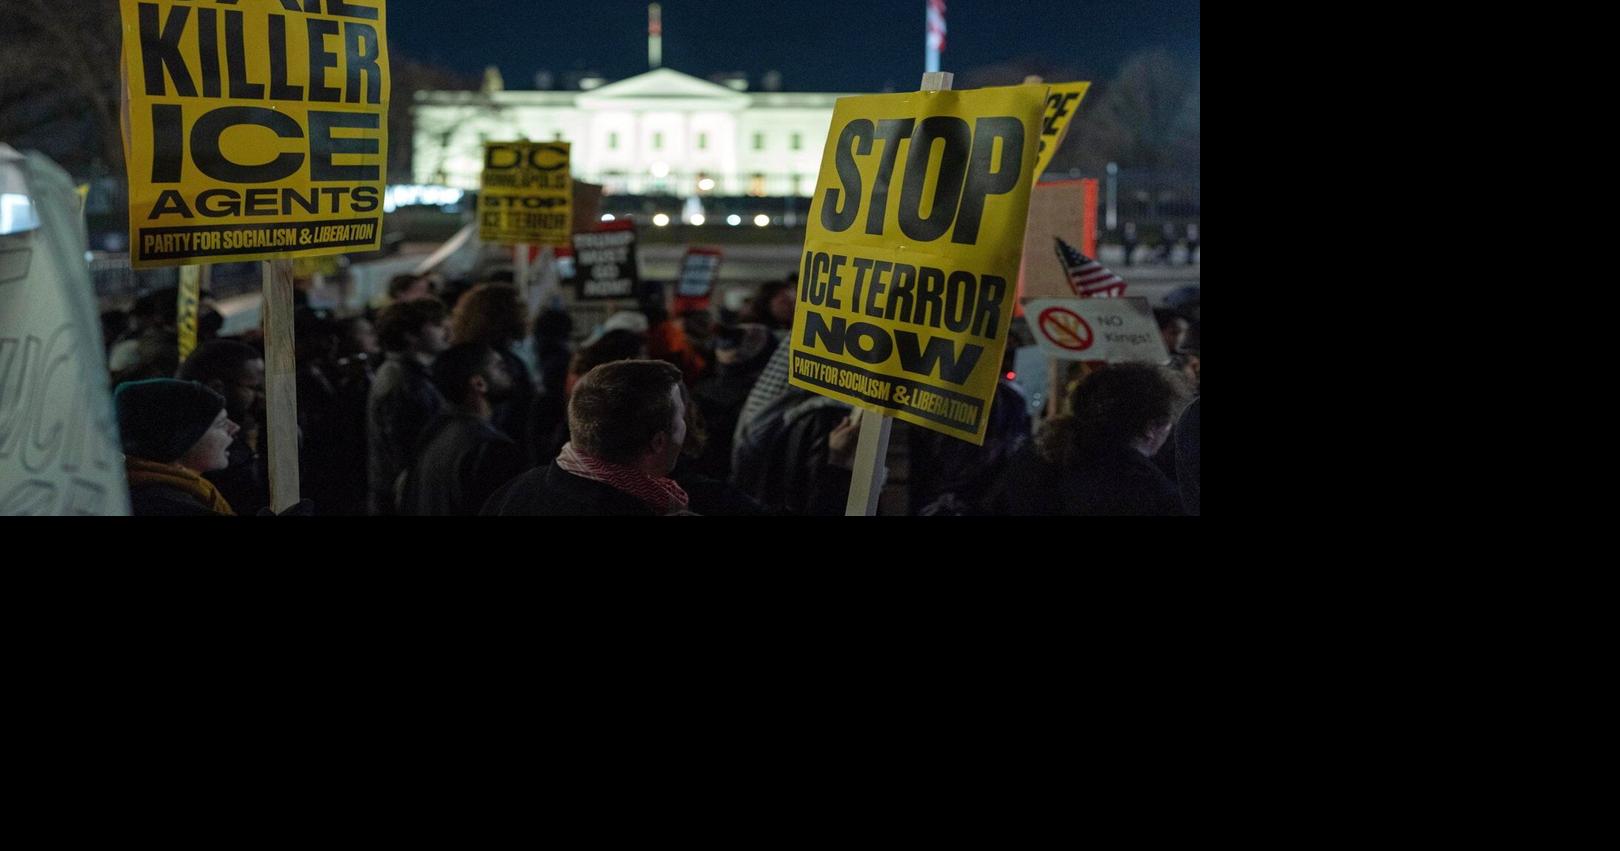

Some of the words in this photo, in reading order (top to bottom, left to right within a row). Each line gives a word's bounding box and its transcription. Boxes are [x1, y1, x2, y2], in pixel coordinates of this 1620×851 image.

[138, 2, 381, 105] KILLER
[151, 104, 380, 183] ICE
[1042, 92, 1080, 135] CE
[485, 145, 568, 171] DC
[820, 115, 1025, 246] STOP
[144, 232, 191, 254] PARTY
[193, 231, 220, 250] FOR
[223, 228, 297, 249] SOCIALISM
[299, 227, 312, 245] &
[313, 223, 375, 243] LIBERATION
[148, 186, 378, 219] AGENTS
[801, 251, 847, 311] ICE
[851, 257, 1006, 340] TERROR
[802, 310, 984, 386] NOW
[794, 356, 821, 380] PARTY
[820, 364, 839, 386] FOR
[839, 369, 891, 402] SOCIALISM
[893, 385, 909, 407] &
[911, 387, 978, 426] LIBERATION
